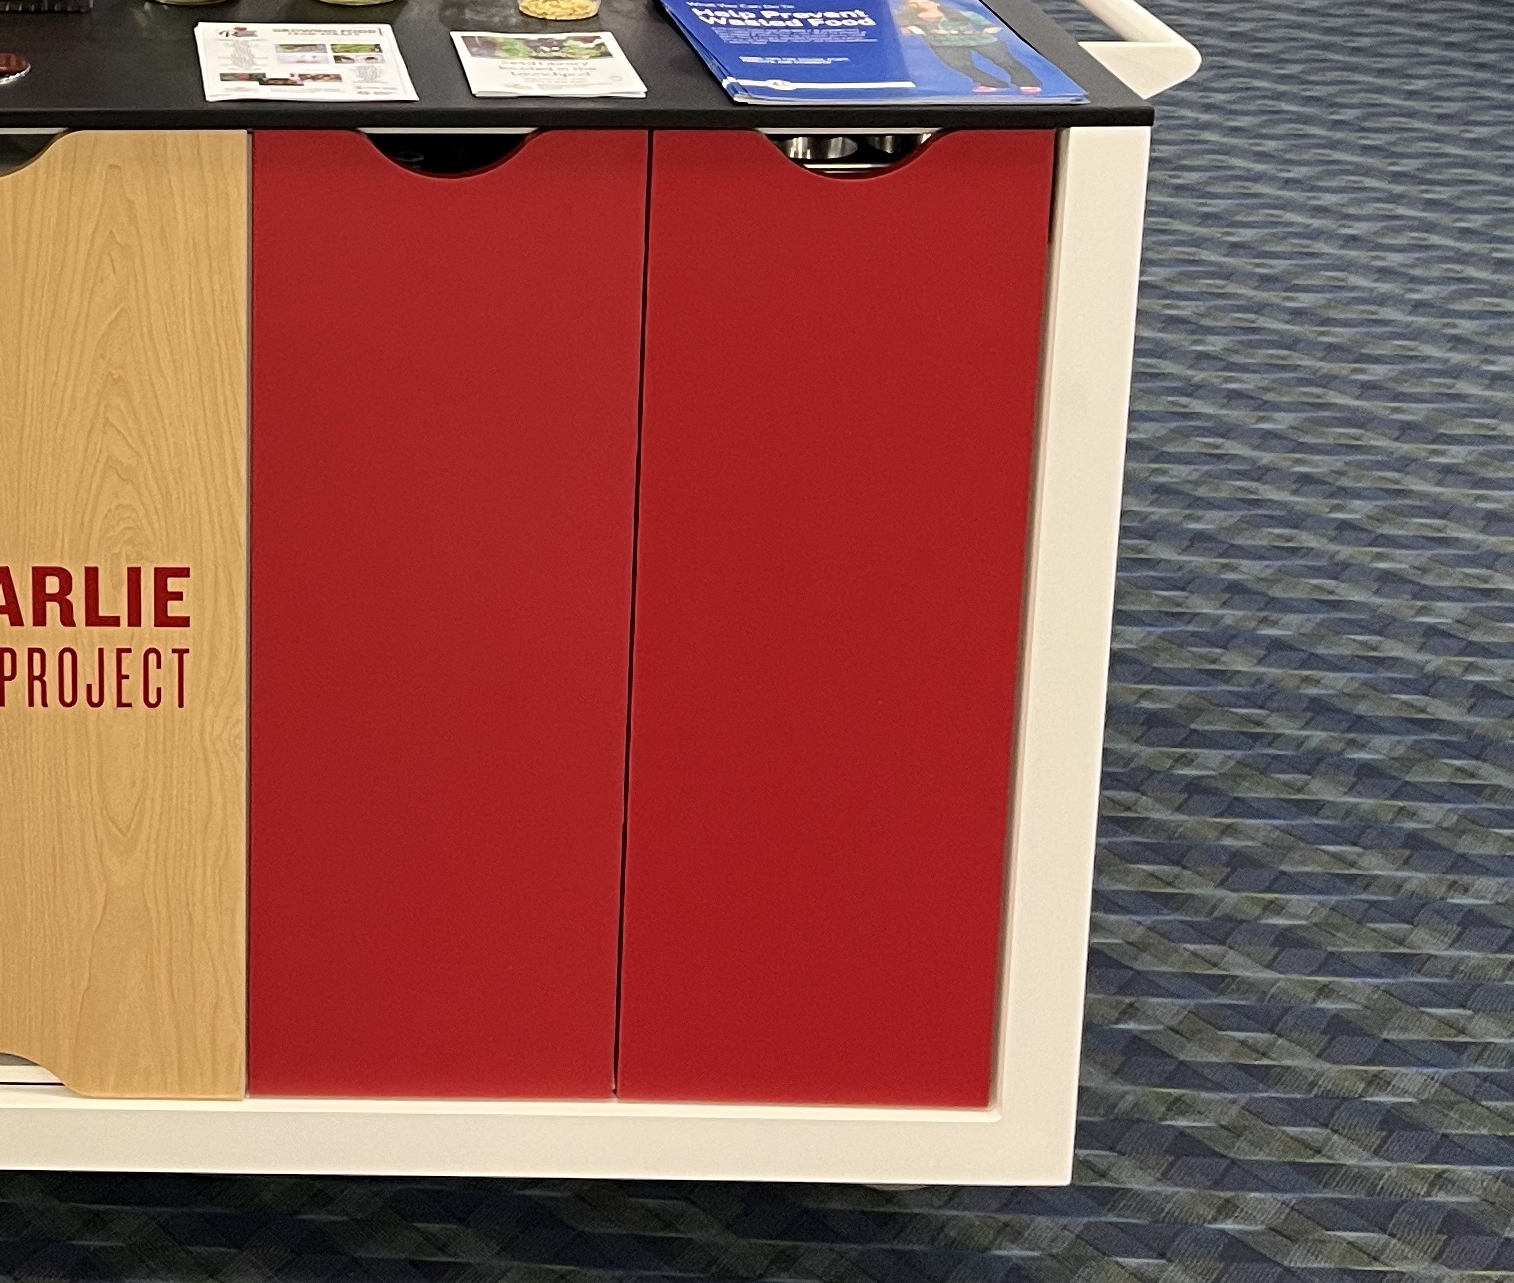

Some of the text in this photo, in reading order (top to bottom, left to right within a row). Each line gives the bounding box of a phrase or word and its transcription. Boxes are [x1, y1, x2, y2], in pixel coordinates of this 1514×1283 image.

[692, 8, 869, 19] Help Prevent
[698, 16, 876, 27] Wasted Food
